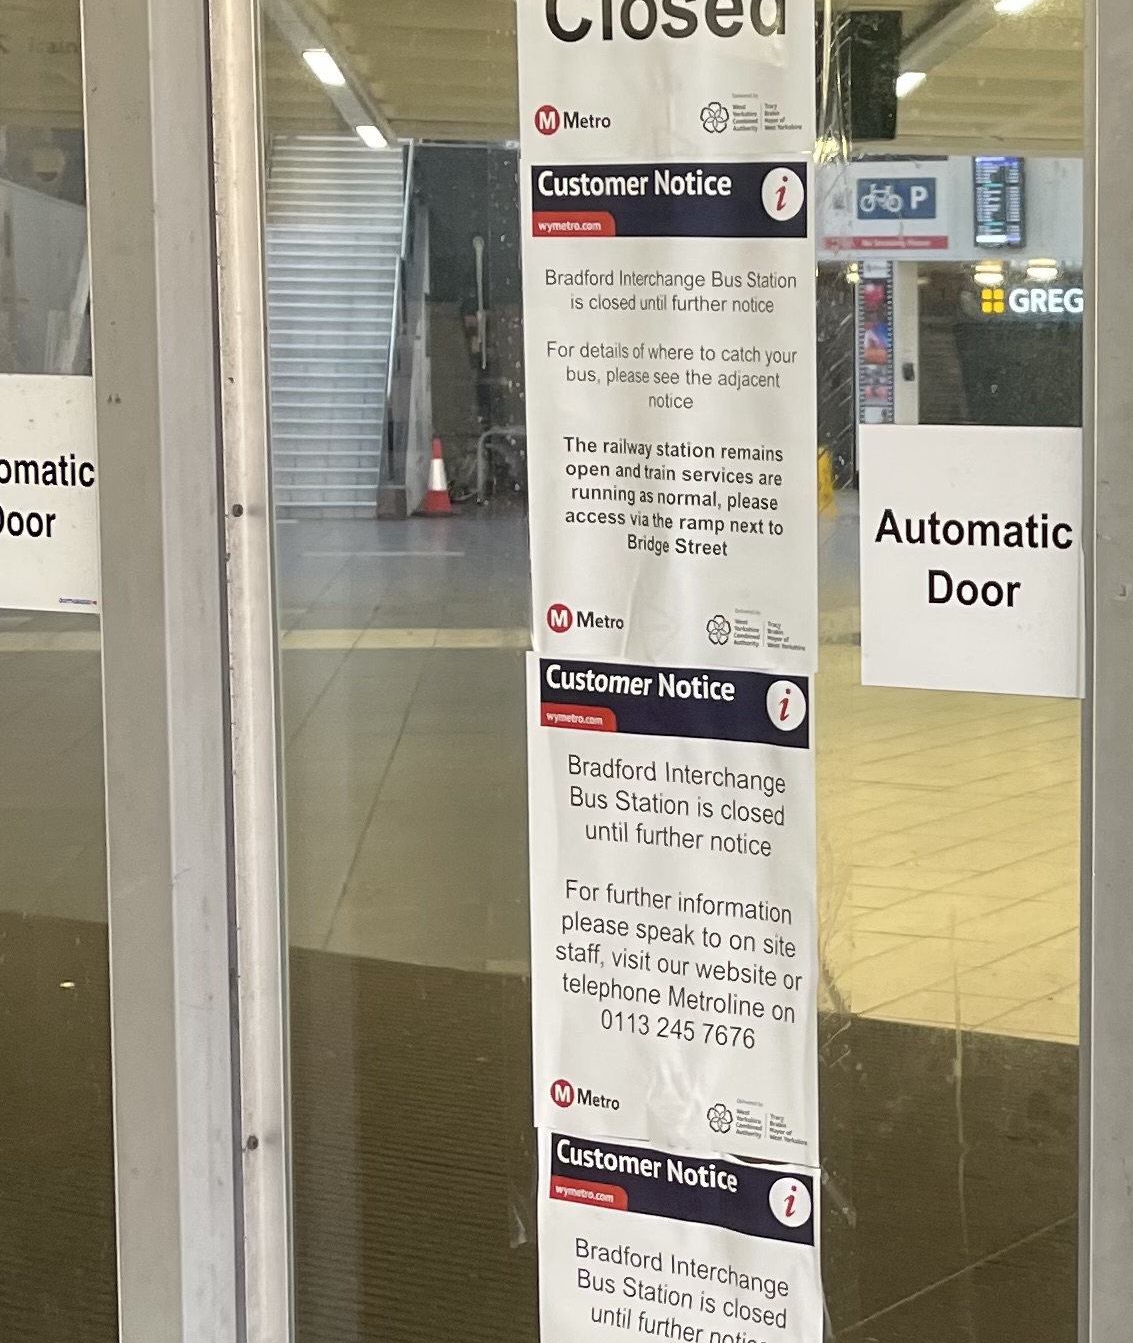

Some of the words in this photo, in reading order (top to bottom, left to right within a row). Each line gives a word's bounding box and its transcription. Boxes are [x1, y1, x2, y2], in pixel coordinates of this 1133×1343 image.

[563, 111, 611, 130] Metro
[910, 186, 928, 209] P
[1009, 288, 1083, 313] GREG
[0, 453, 95, 487] omatic
[0, 507, 56, 538] oor
[874, 508, 1073, 550] Automatic
[928, 569, 1022, 608] Door
[545, 664, 653, 696] Customer
[658, 672, 735, 702] Notice
[545, 712, 604, 726] wymetro.com
[568, 753, 657, 782] Bradford
[665, 761, 786, 798] Interchange
[570, 785, 609, 810] Bus
[615, 789, 689, 816] Station
[697, 795, 714, 818] is
[720, 798, 785, 827] closed
[585, 821, 629, 843] until
[635, 822, 705, 850] further
[710, 832, 772, 858] notice
[565, 878, 600, 902] For
[605, 882, 673, 910] further
[678, 891, 792, 926] information
[561, 910, 629, 937] please
[635, 922, 695, 946] speak
[701, 926, 722, 949] to
[729, 934, 756, 952] on
[763, 933, 796, 958] site
[555, 942, 605, 968] staff,
[611, 947, 651, 972] visit
[657, 957, 690, 976] our
[695, 960, 777, 987] website
[783, 973, 803, 992] or
[562, 972, 661, 1005] telephone
[668, 984, 765, 1018] Metroline
[771, 1004, 795, 1024] on
[601, 1008, 650, 1036] 0113
[656, 1016, 695, 1042] 245
[702, 1022, 755, 1050] 7676
[577, 1087, 620, 1111] Metro
